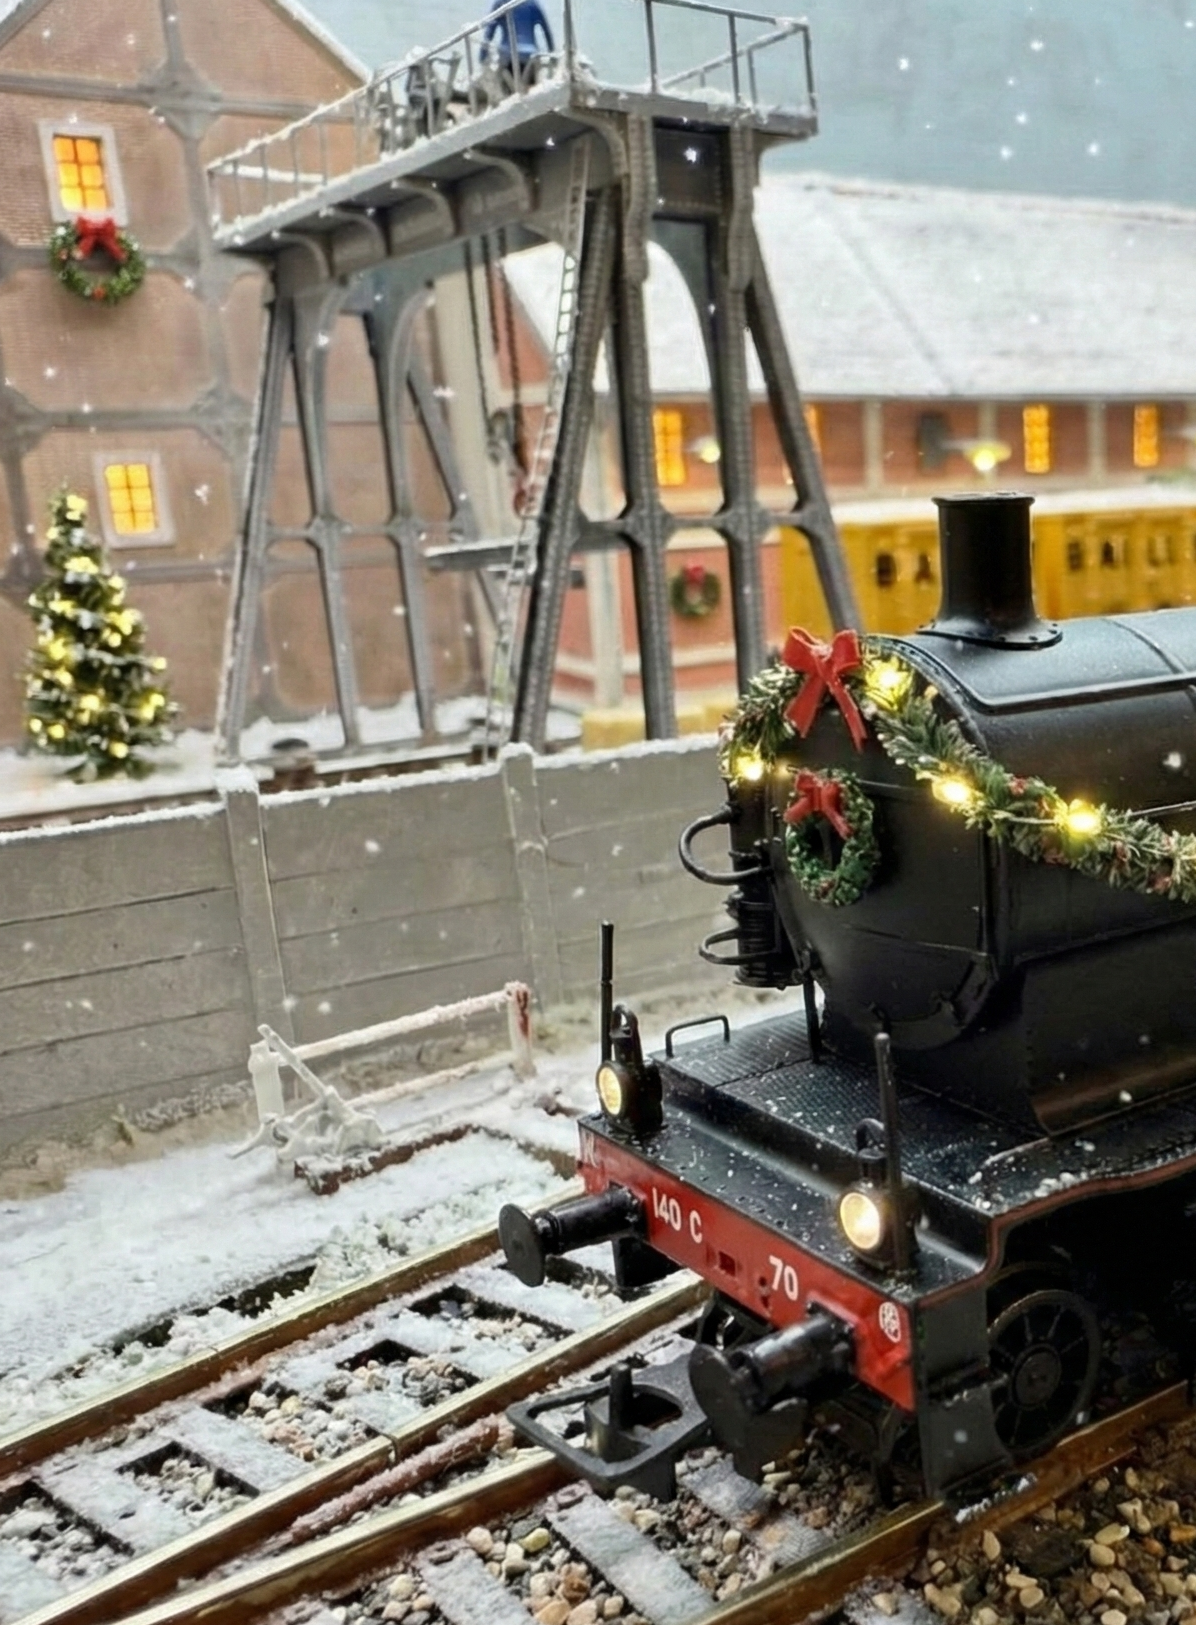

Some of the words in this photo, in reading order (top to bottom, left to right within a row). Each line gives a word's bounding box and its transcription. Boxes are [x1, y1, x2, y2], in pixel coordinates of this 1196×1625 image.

[652, 1186, 682, 1232] 140
[689, 1209, 703, 1244] C
[768, 1254, 799, 1301] 70
